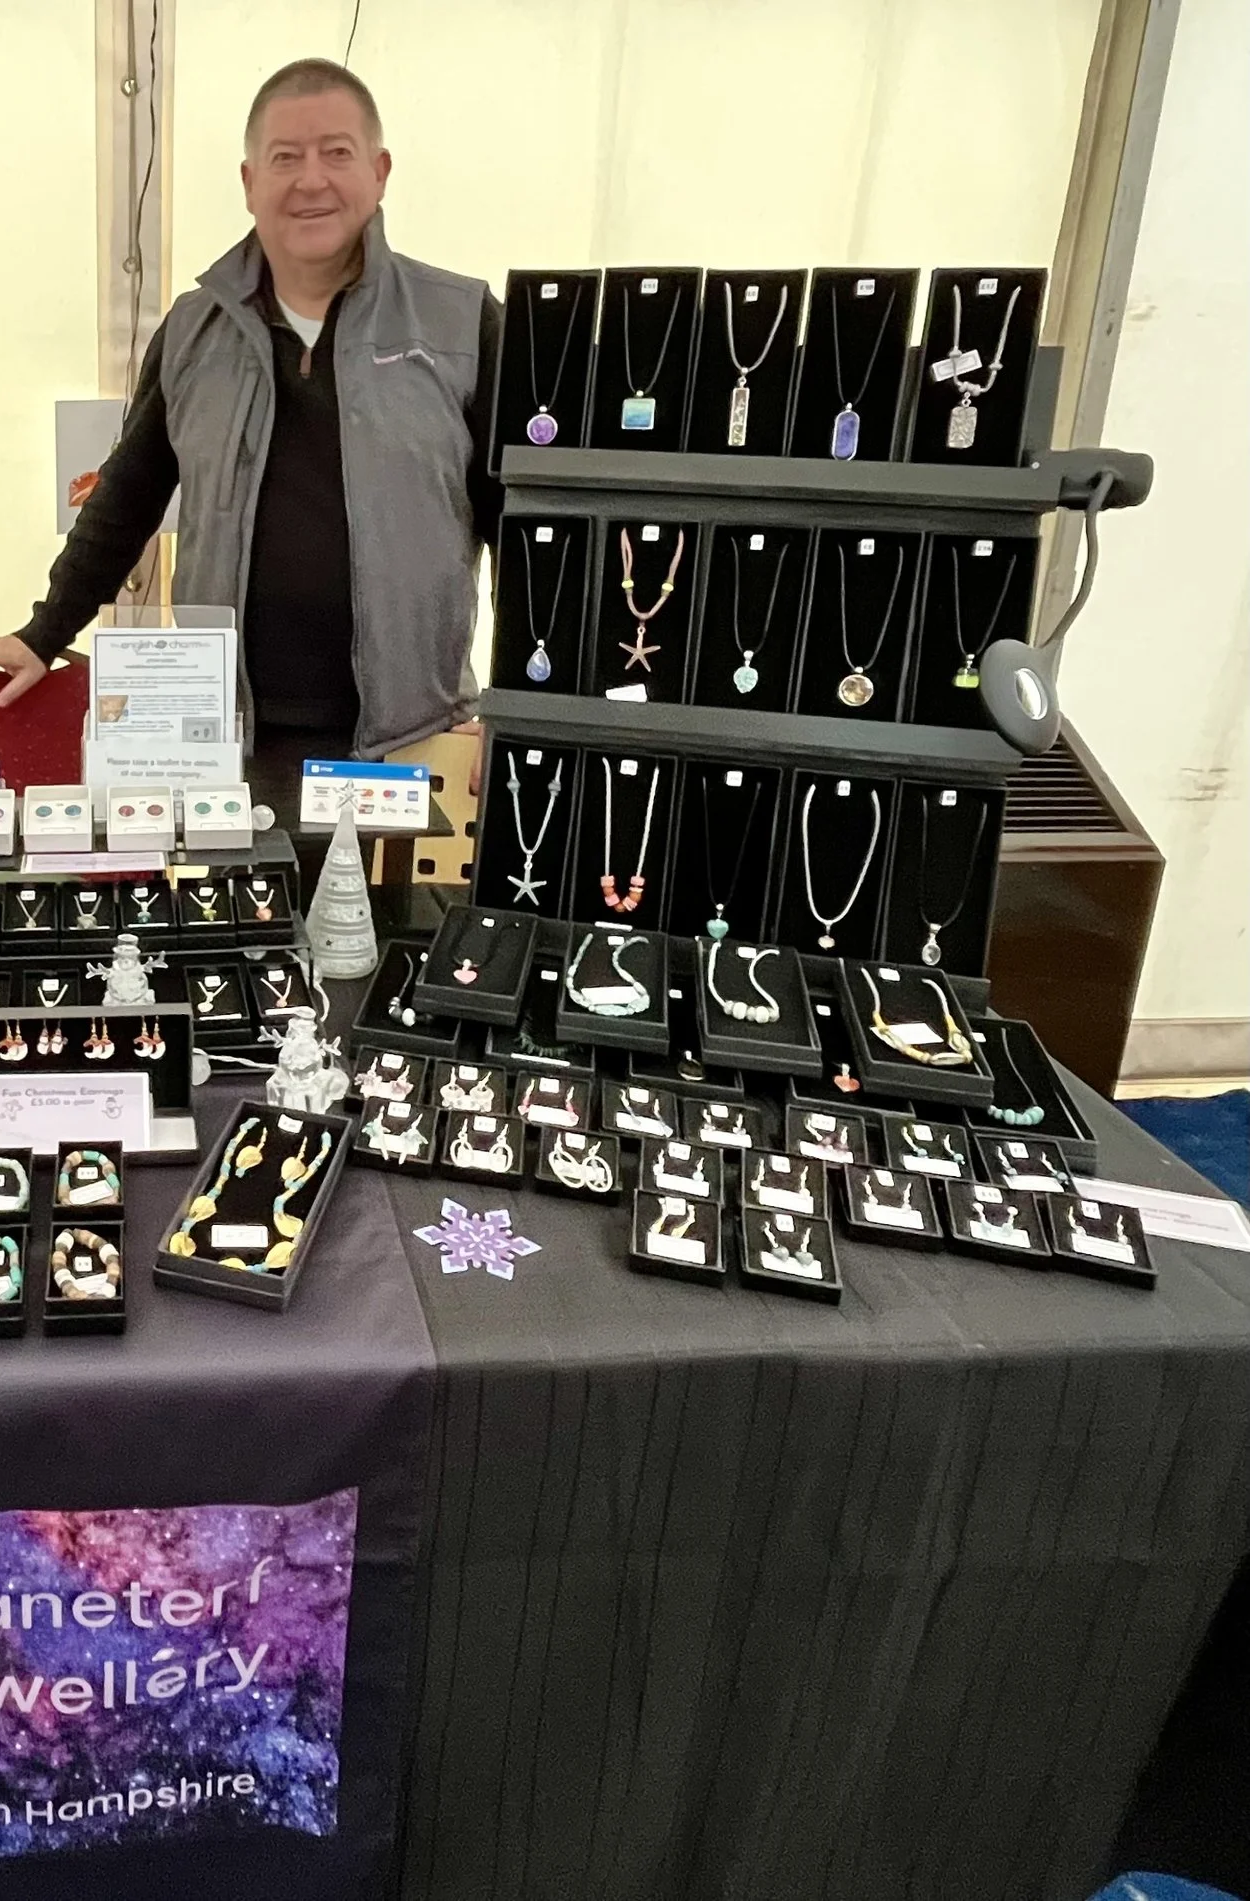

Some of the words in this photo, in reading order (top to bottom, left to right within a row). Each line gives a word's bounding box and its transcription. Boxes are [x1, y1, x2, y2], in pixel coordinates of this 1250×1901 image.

[2, 1088, 21, 1097] Fun
[25, 1087, 76, 1096] Christmas
[79, 1087, 124, 1096] Earrings
[25, 1771, 257, 1827] Hampshire
